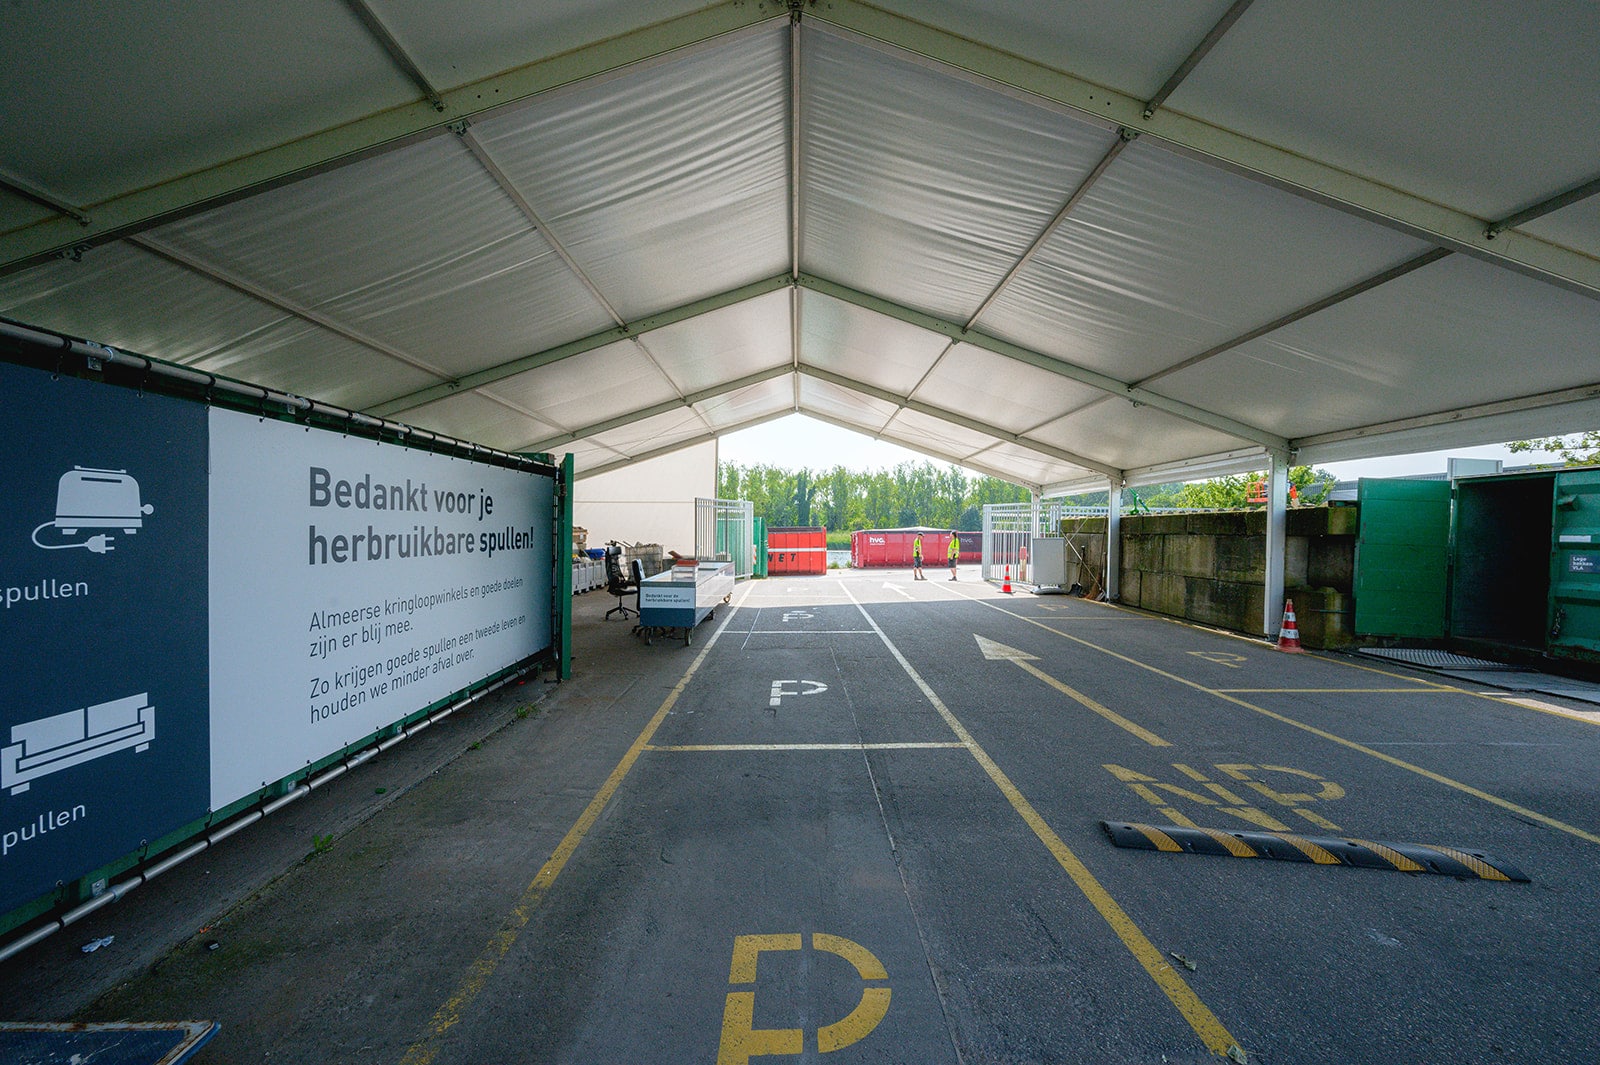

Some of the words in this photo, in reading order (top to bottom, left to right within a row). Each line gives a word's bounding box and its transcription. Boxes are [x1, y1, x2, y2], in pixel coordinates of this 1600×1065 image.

[309, 466, 428, 513] Bedankt
[434, 490, 476, 514] voor
[478, 487, 494, 522] je
[308, 524, 475, 566] herbruikbare
[479, 526, 534, 559] spullen!
[308, 605, 381, 632] Almeerse
[384, 585, 468, 615] kringloopwinkels
[470, 586, 480, 598] en
[481, 579, 502, 599] goede
[503, 577, 524, 591] doelen
[309, 634, 337, 660] zijn
[342, 632, 358, 648] er
[361, 622, 381, 645] blij
[385, 620, 414, 638] mee.
[309, 677, 330, 700] Zo
[335, 665, 383, 690] krijgen
[386, 648, 420, 676] goede
[423, 636, 457, 660] spullen
[458, 631, 474, 646] een
[475, 620, 501, 640] tweede
[501, 616, 518, 631] leven
[518, 615, 526, 625] en
[310, 691, 366, 725] houden
[369, 682, 388, 700] we
[391, 666, 430, 691] minder
[432, 653, 454, 675] afval
[456, 648, 475, 665] over.
[769, 680, 828, 706] P
[716, 932, 892, 1065] P
